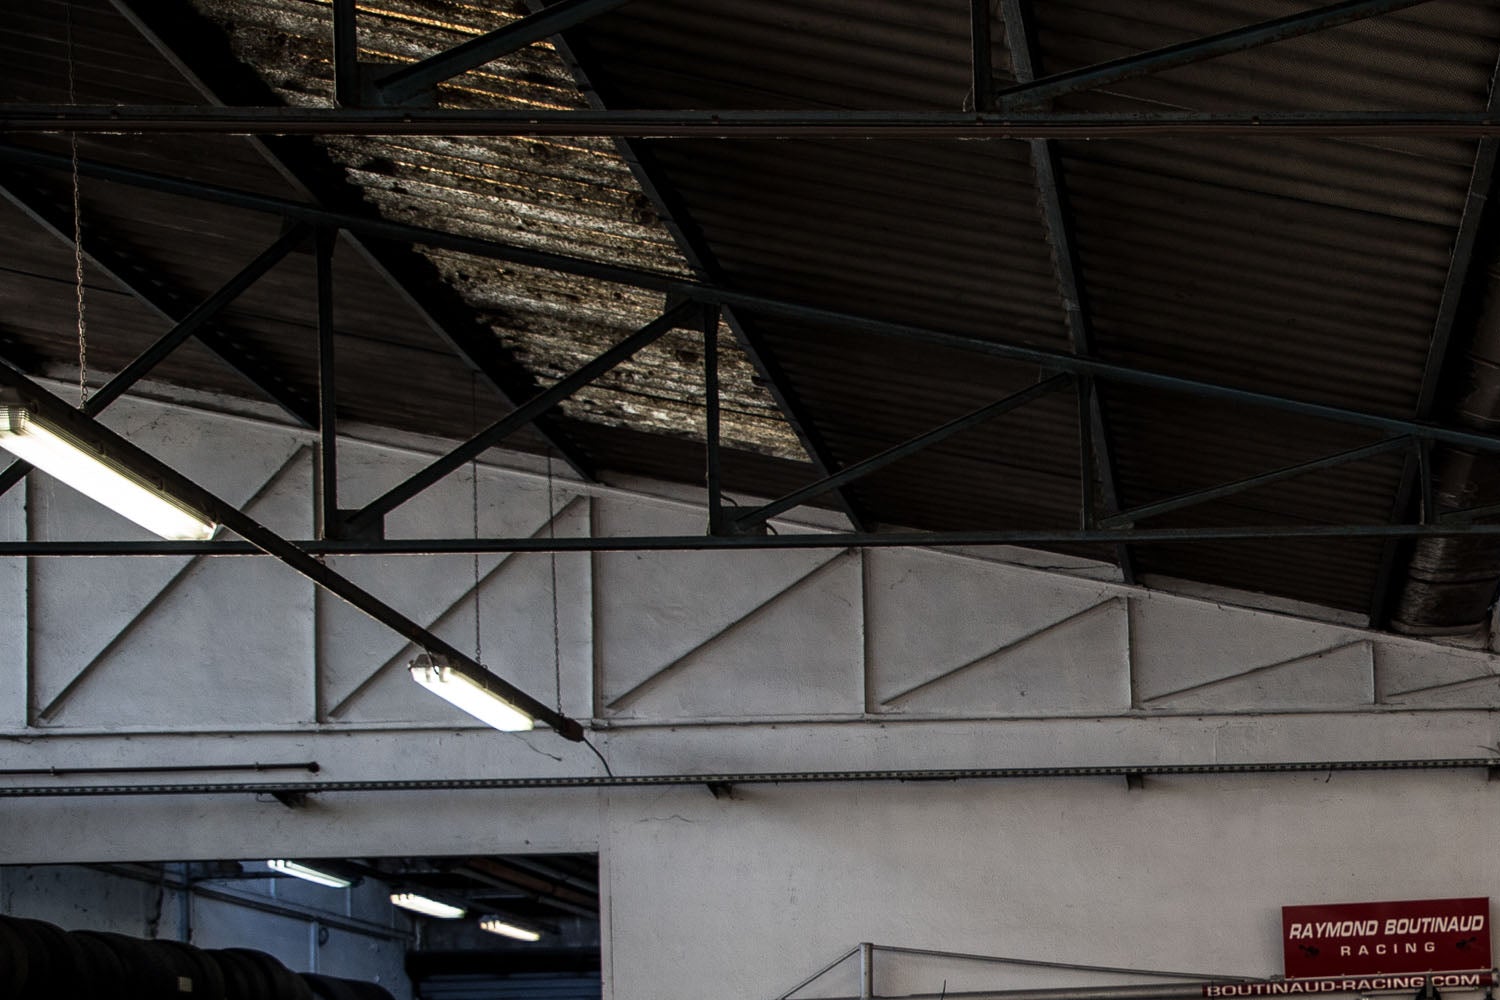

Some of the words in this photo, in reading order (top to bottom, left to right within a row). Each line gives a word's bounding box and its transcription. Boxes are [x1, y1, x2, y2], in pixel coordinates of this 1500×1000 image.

[1289, 920, 1378, 939] RAYMOND
[1384, 915, 1484, 935] BOUTINAUD
[1340, 941, 1436, 956] RACING
[1206, 974, 1480, 997] BOUTINAUD-RACINGCOM
